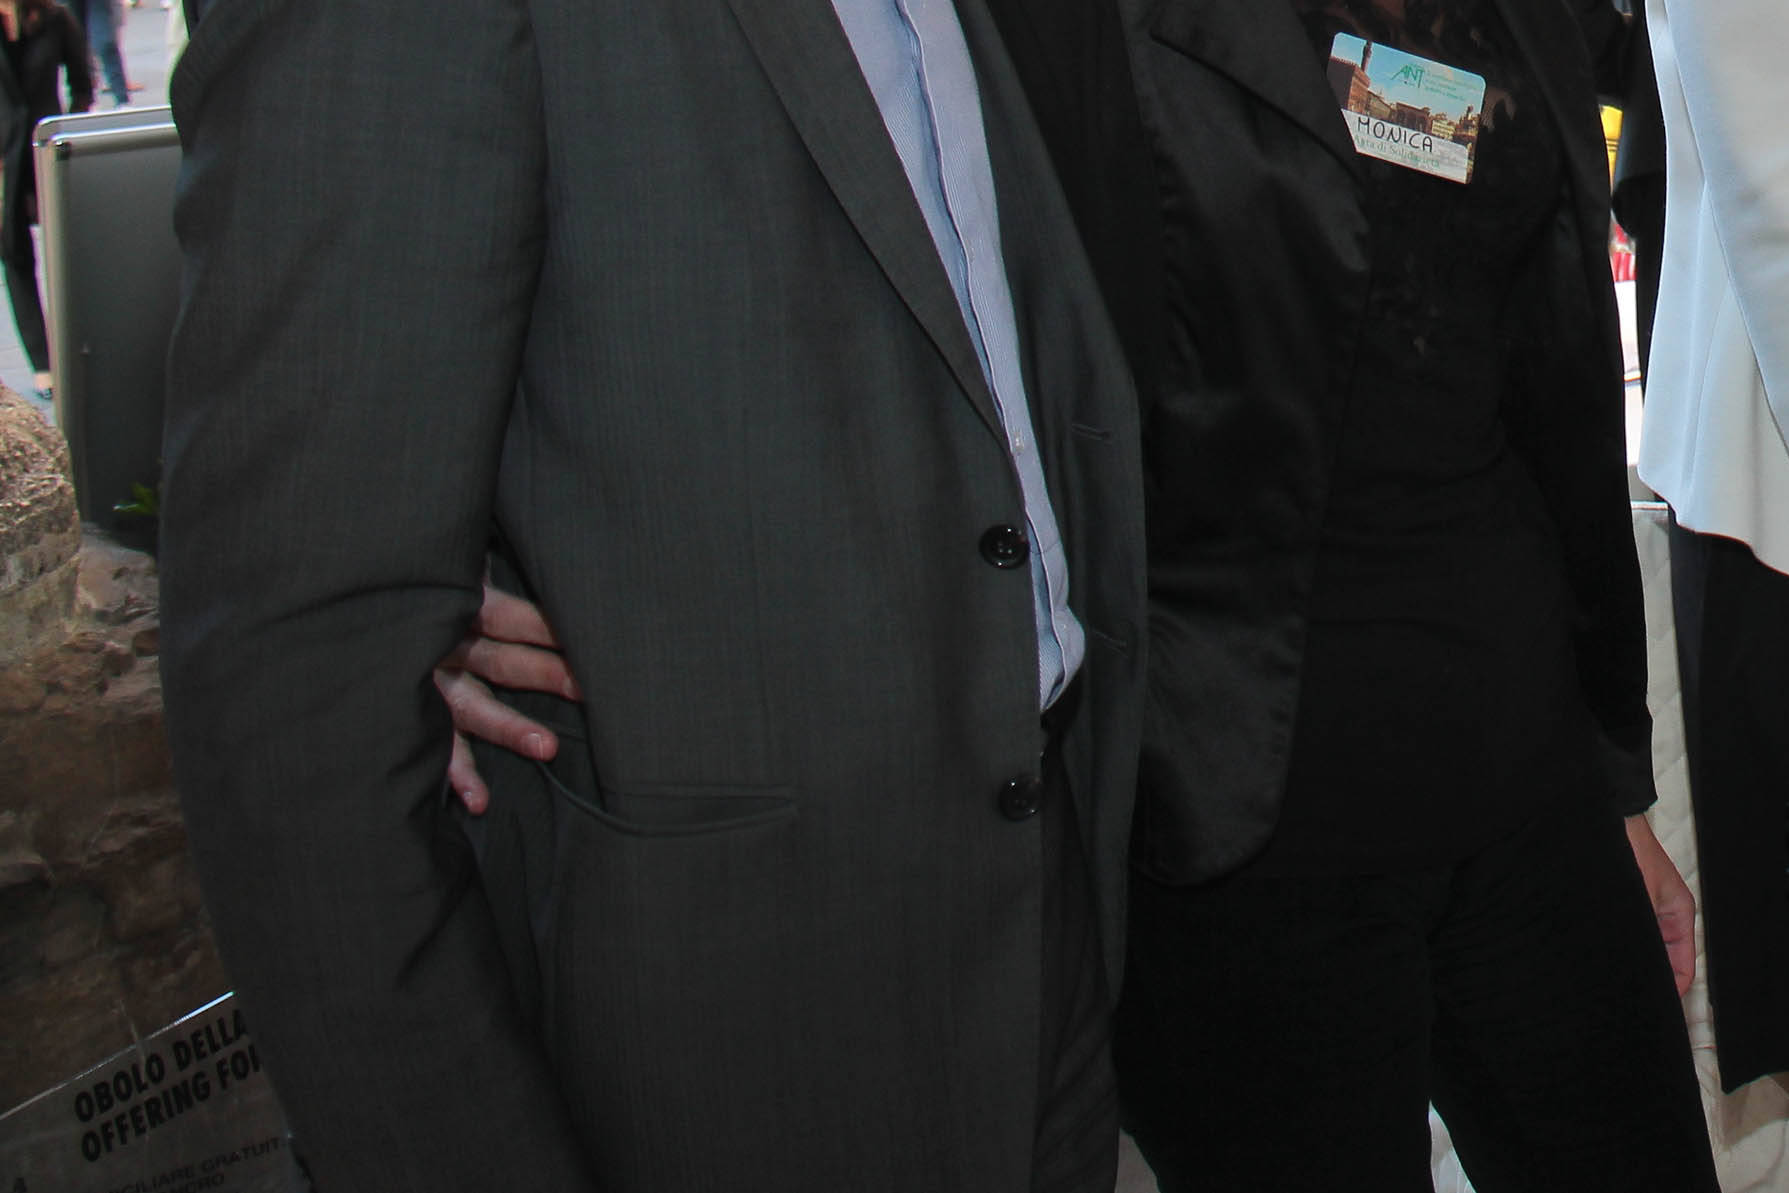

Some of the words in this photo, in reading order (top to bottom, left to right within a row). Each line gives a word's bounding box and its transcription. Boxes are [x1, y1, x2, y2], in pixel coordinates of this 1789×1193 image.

[1357, 116, 1433, 153] MONICA
[74, 1052, 166, 1123] OBOLO
[81, 1070, 211, 1162] OFFERING
[201, 1137, 281, 1173] GRATUIT
